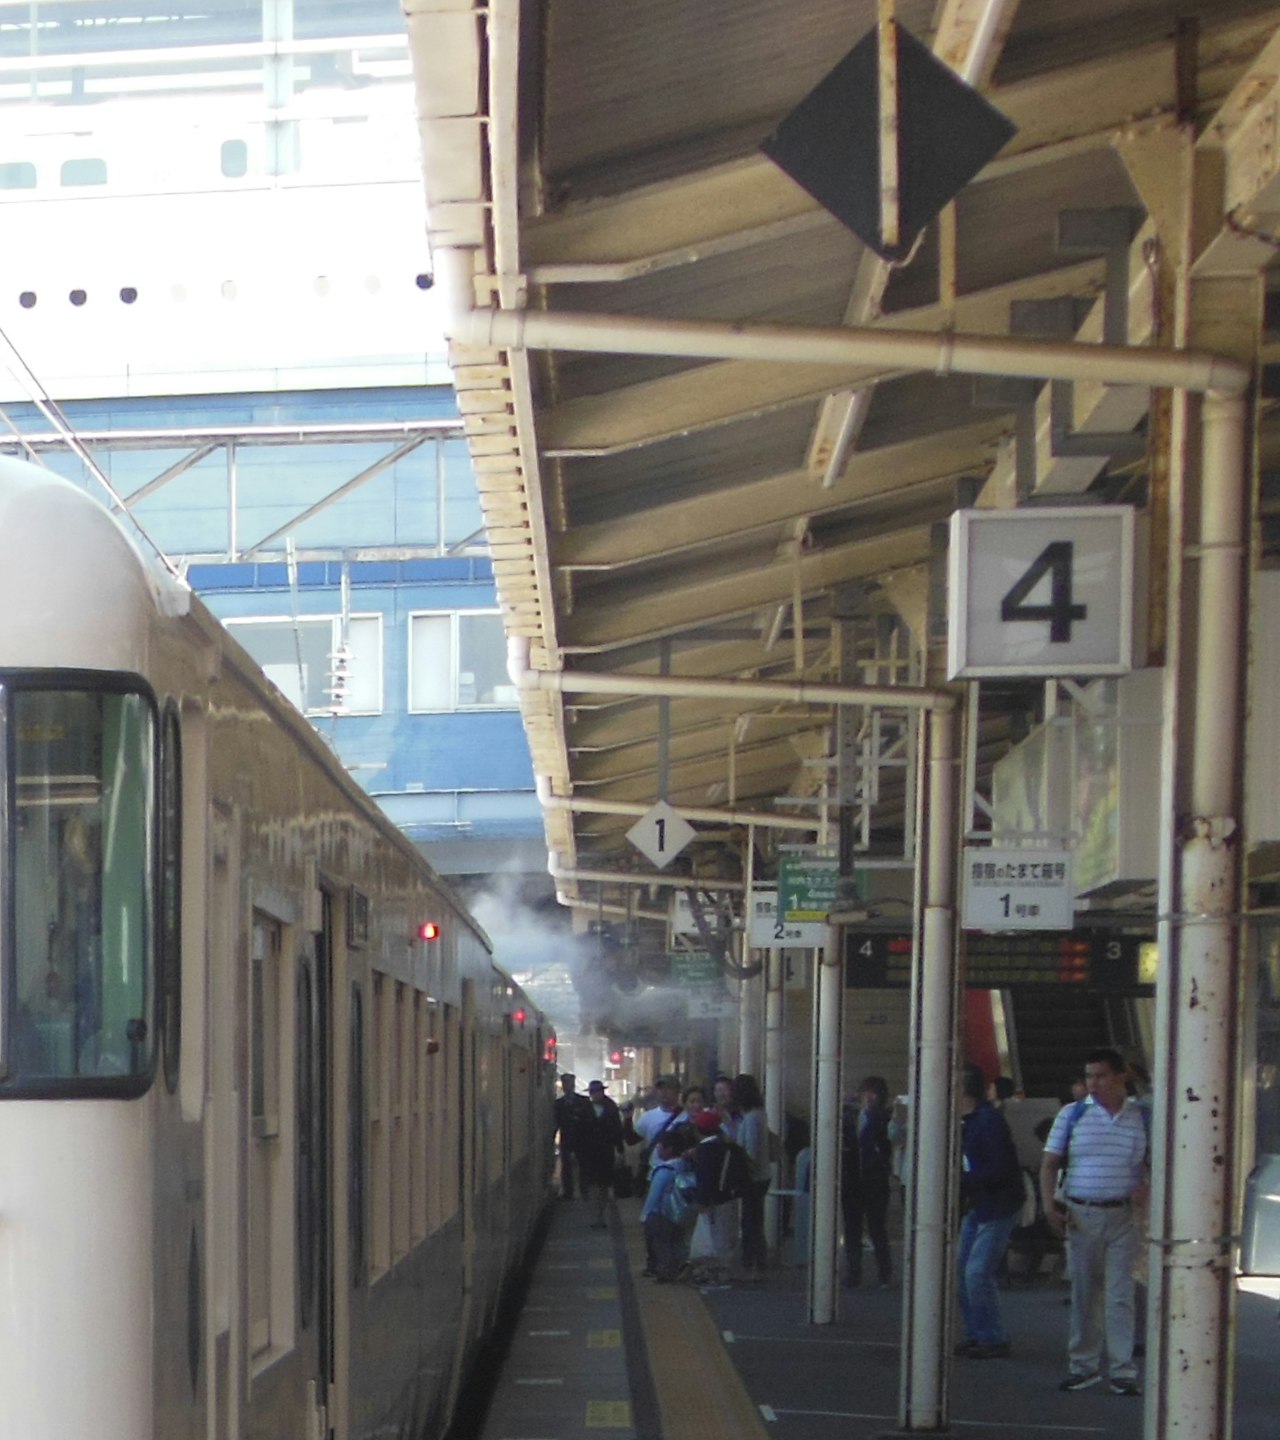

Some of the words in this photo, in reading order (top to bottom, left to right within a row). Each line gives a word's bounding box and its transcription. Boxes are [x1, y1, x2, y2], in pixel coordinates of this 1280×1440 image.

[1001, 541, 1087, 643] 4
[655, 818, 665, 852] 1
[859, 940, 872, 956] 4
[1107, 941, 1121, 959] 3
